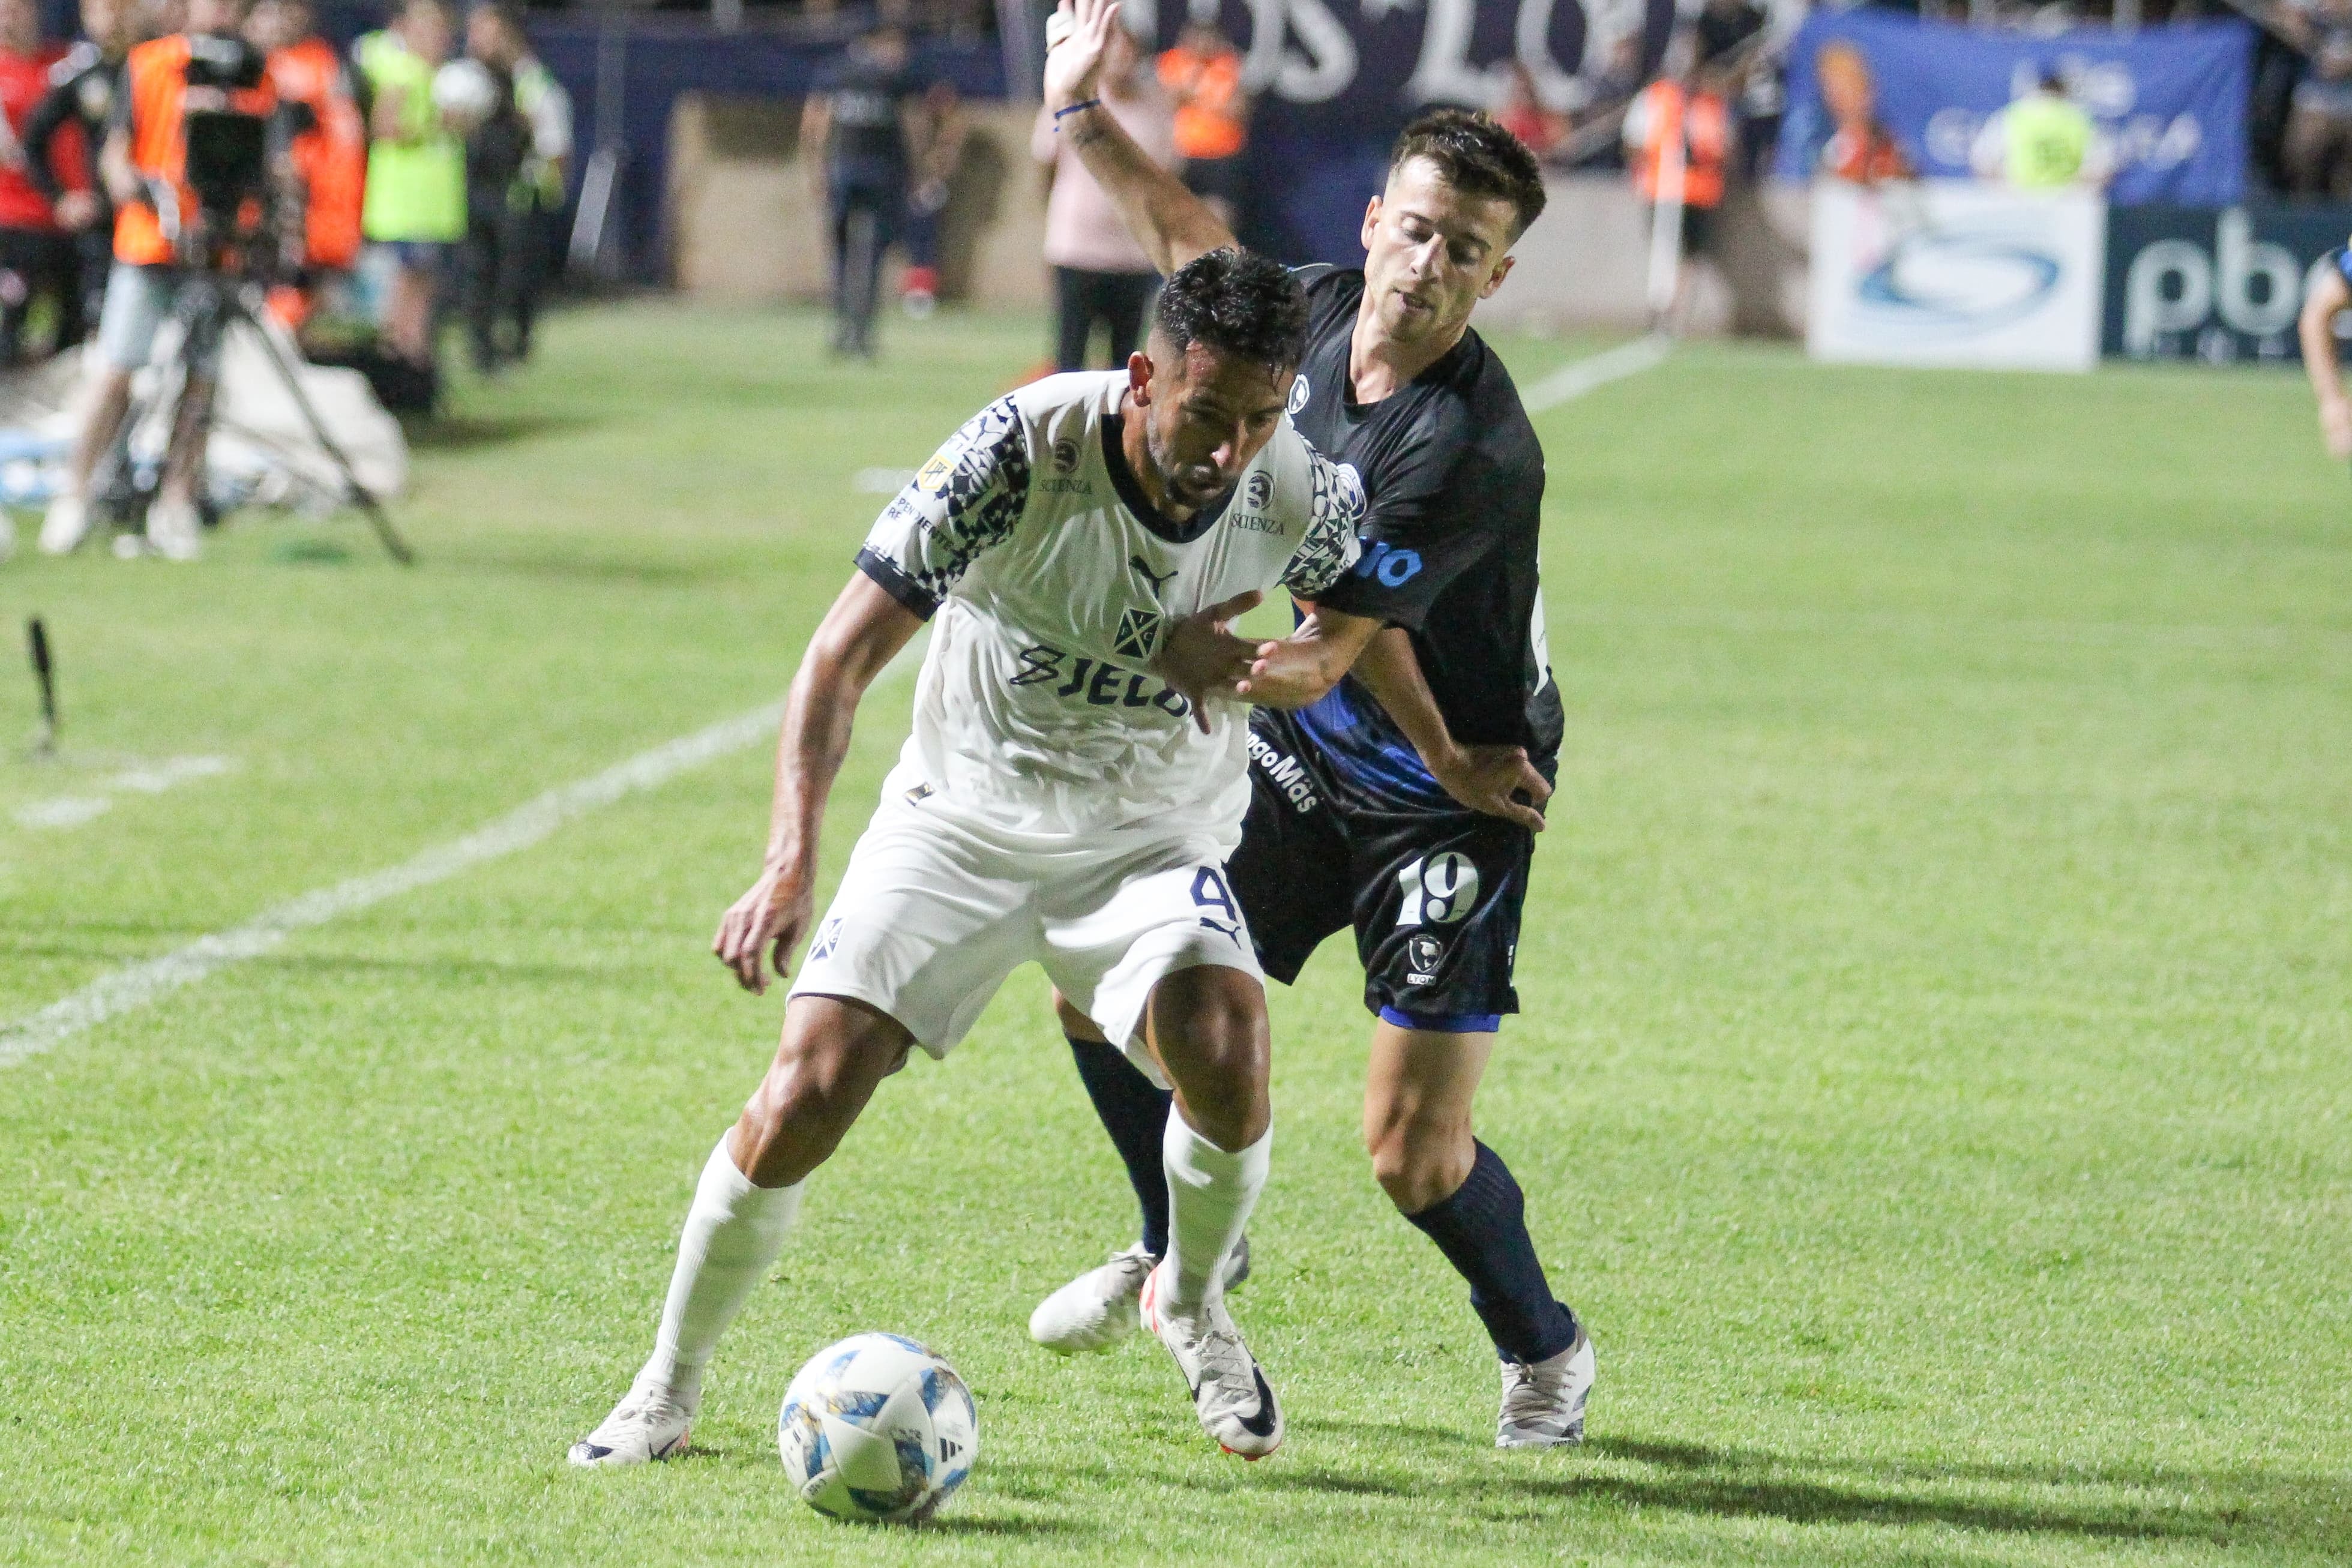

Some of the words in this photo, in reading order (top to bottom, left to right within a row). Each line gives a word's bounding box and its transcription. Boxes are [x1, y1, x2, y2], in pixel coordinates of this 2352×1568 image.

[2122, 207, 2348, 355] pb
[1231, 513, 1284, 535] SCIENZA
[1247, 731, 1317, 813] ngoMás
[1190, 866, 1238, 923] 4
[1396, 851, 1479, 925] 19
[1408, 974, 1437, 985] LYON
